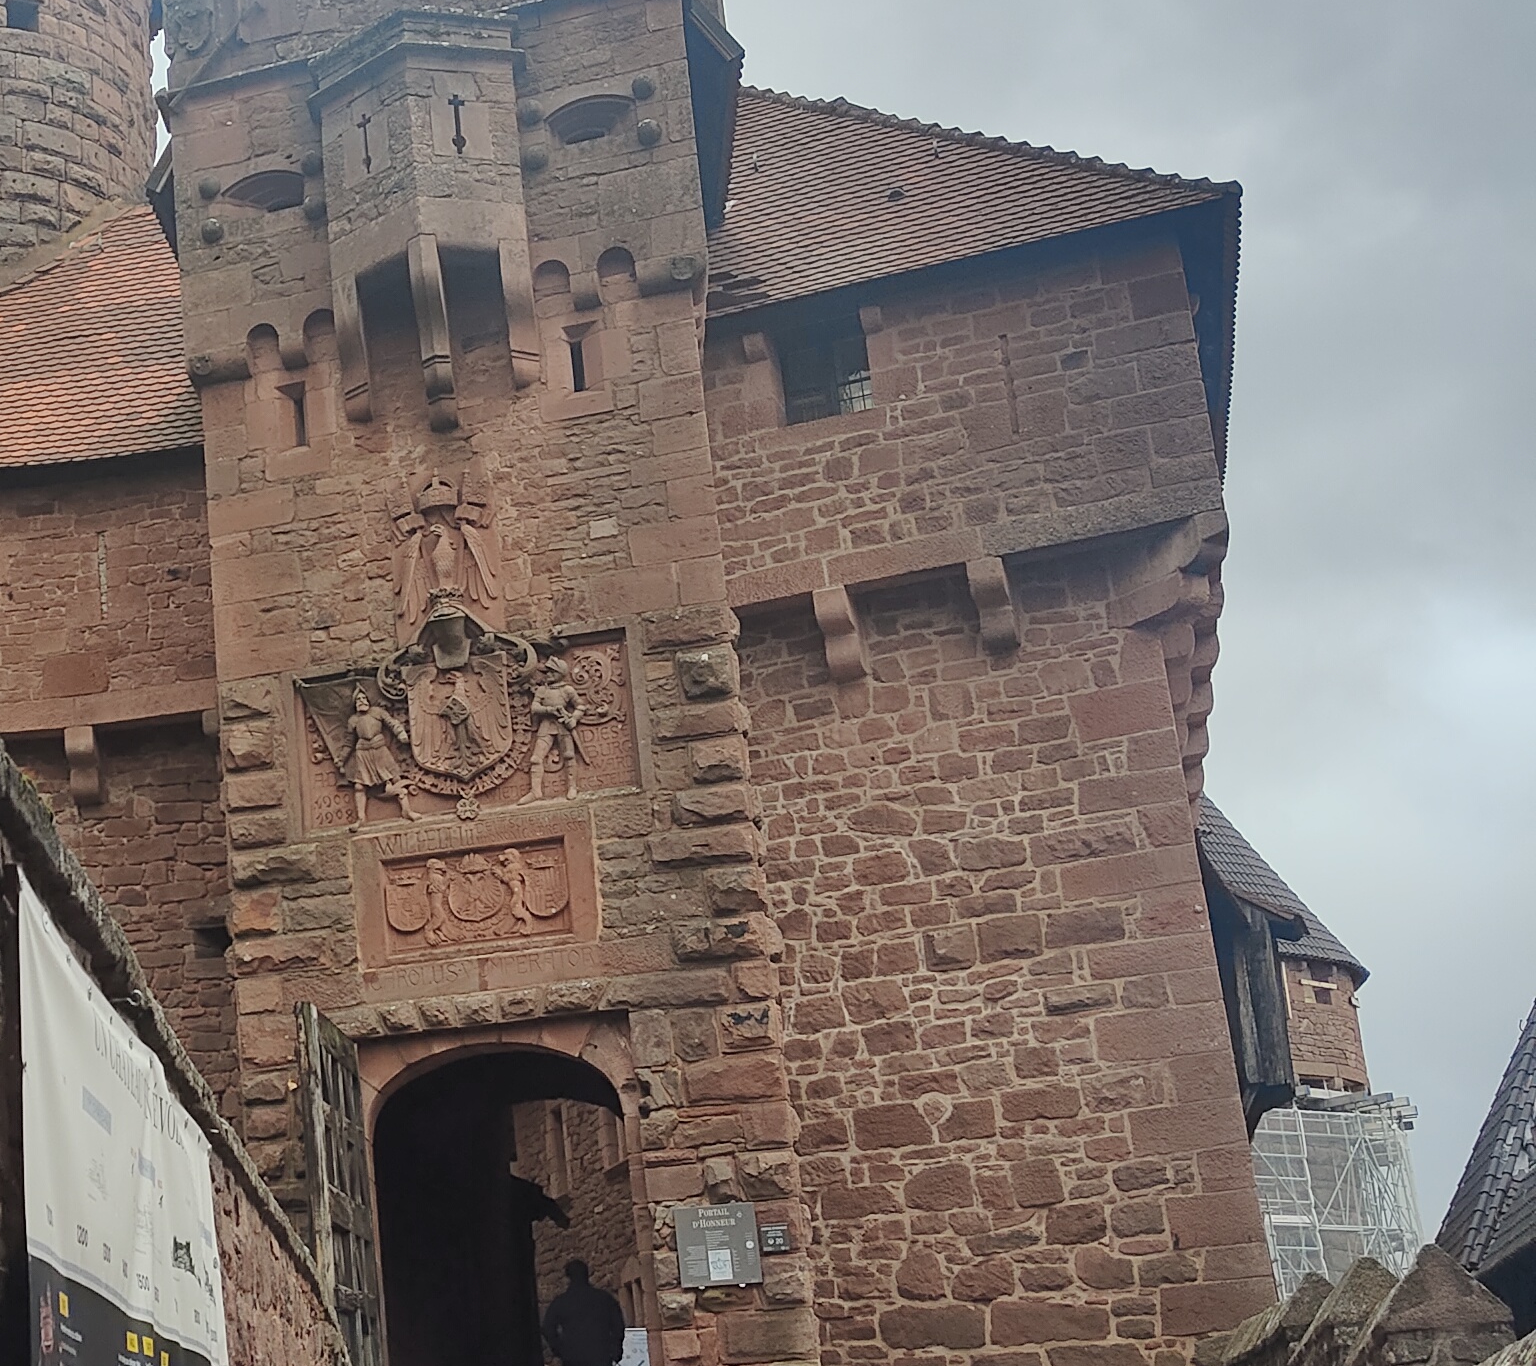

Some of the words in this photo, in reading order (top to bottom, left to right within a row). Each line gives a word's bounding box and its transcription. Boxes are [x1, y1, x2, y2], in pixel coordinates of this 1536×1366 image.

[585, 740, 632, 758] BURG
[314, 793, 351, 809] 1900
[316, 808, 357, 825] 1908
[76, 1224, 89, 1248] 1200
[135, 1273, 150, 1292] 1500
